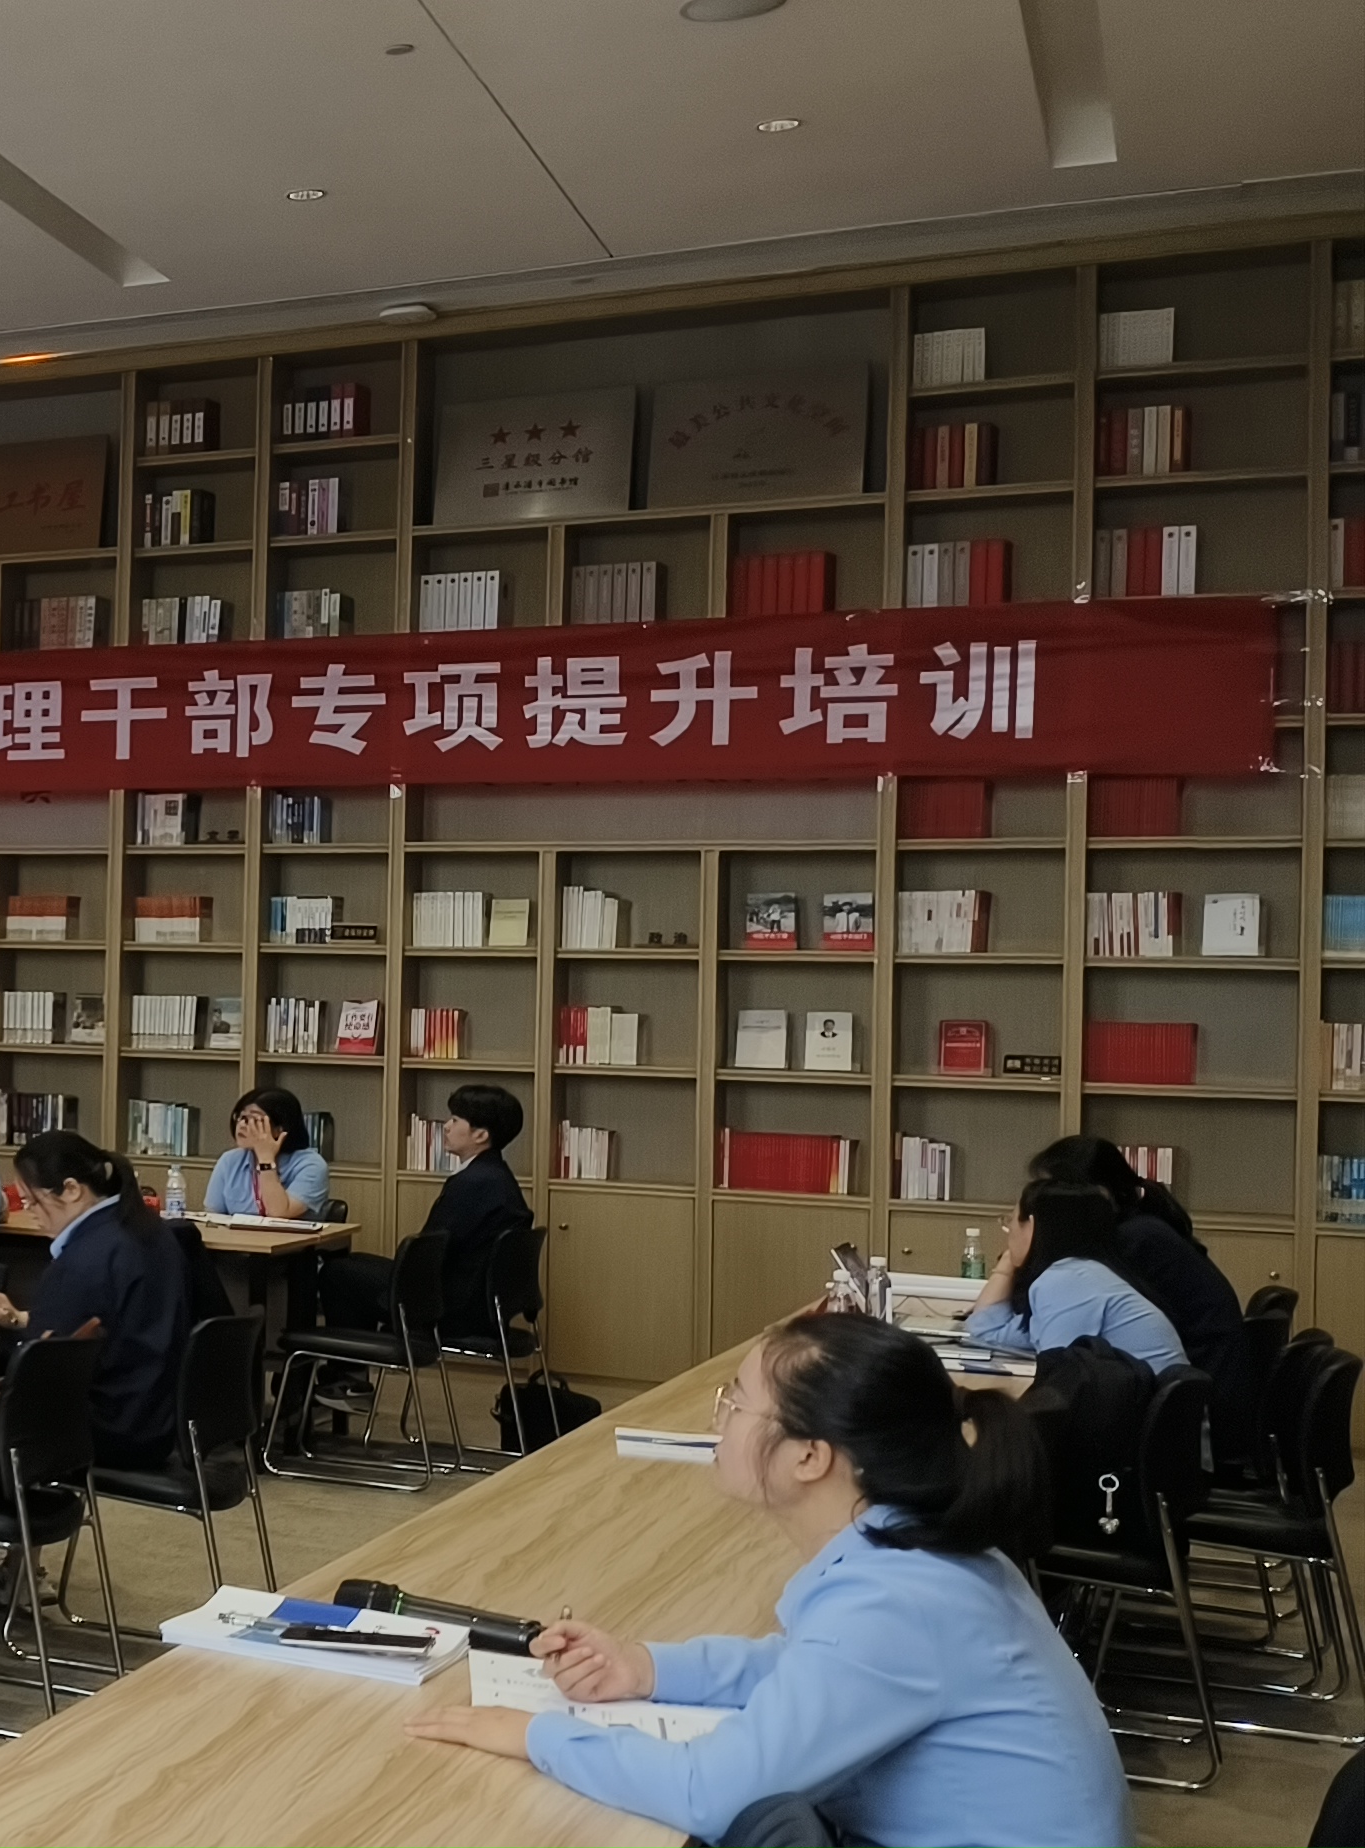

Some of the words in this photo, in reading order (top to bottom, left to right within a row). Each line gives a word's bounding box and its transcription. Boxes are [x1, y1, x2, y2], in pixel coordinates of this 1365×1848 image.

[475, 446, 594, 471] 三星级分馆
[648, 931, 688, 945] 政治
